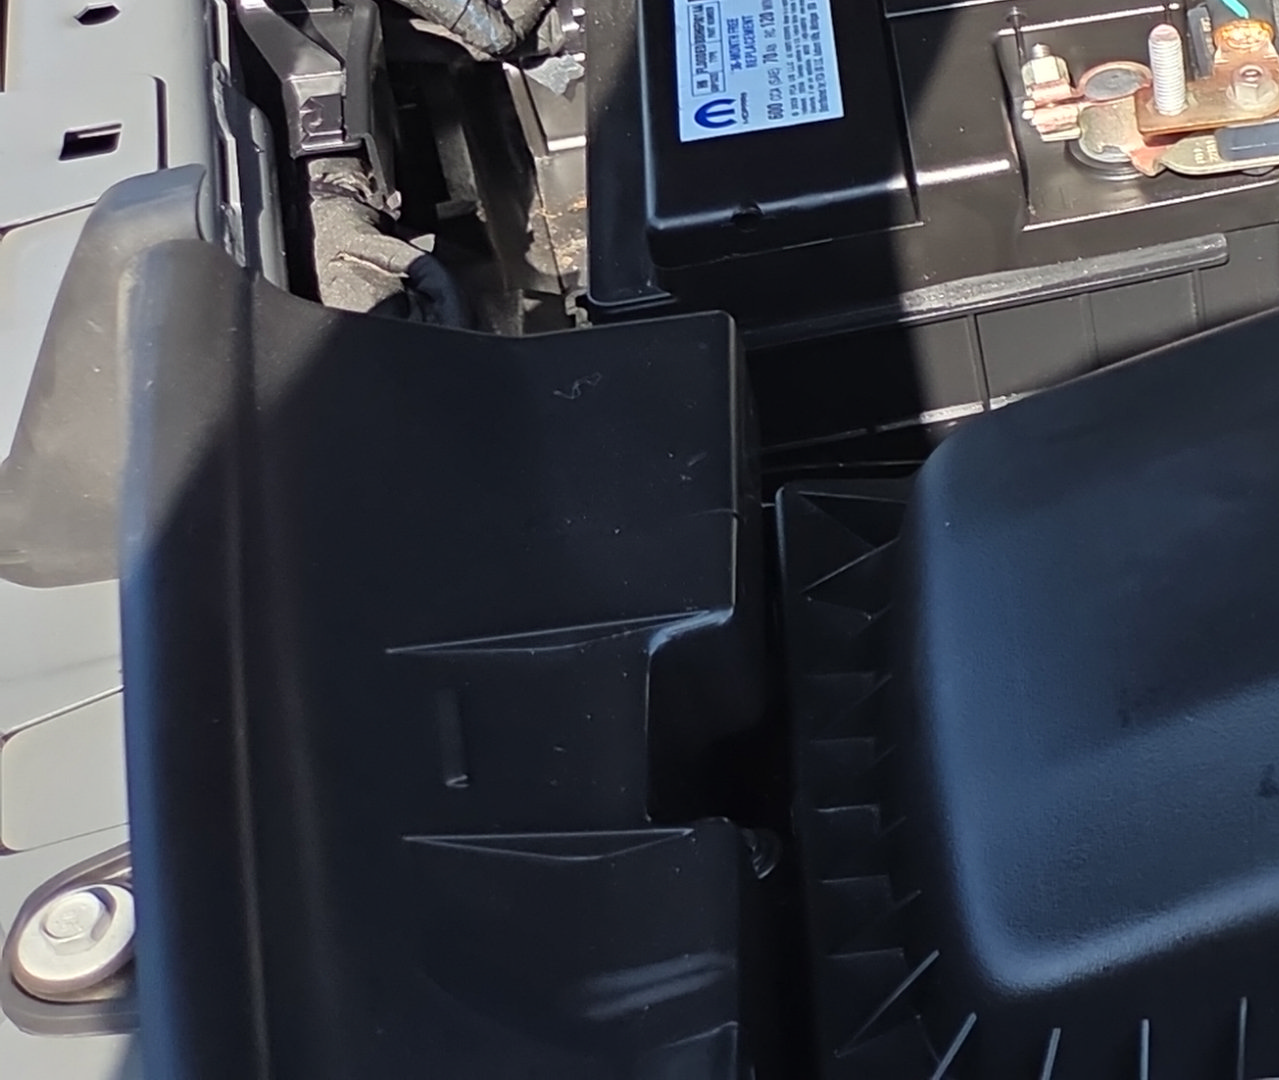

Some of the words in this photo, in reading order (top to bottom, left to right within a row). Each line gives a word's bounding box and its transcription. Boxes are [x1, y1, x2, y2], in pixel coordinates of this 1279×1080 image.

[726, 17, 739, 34] FREE
[758, 11, 775, 27] 120
[741, 14, 757, 68] REPLACEMENT
